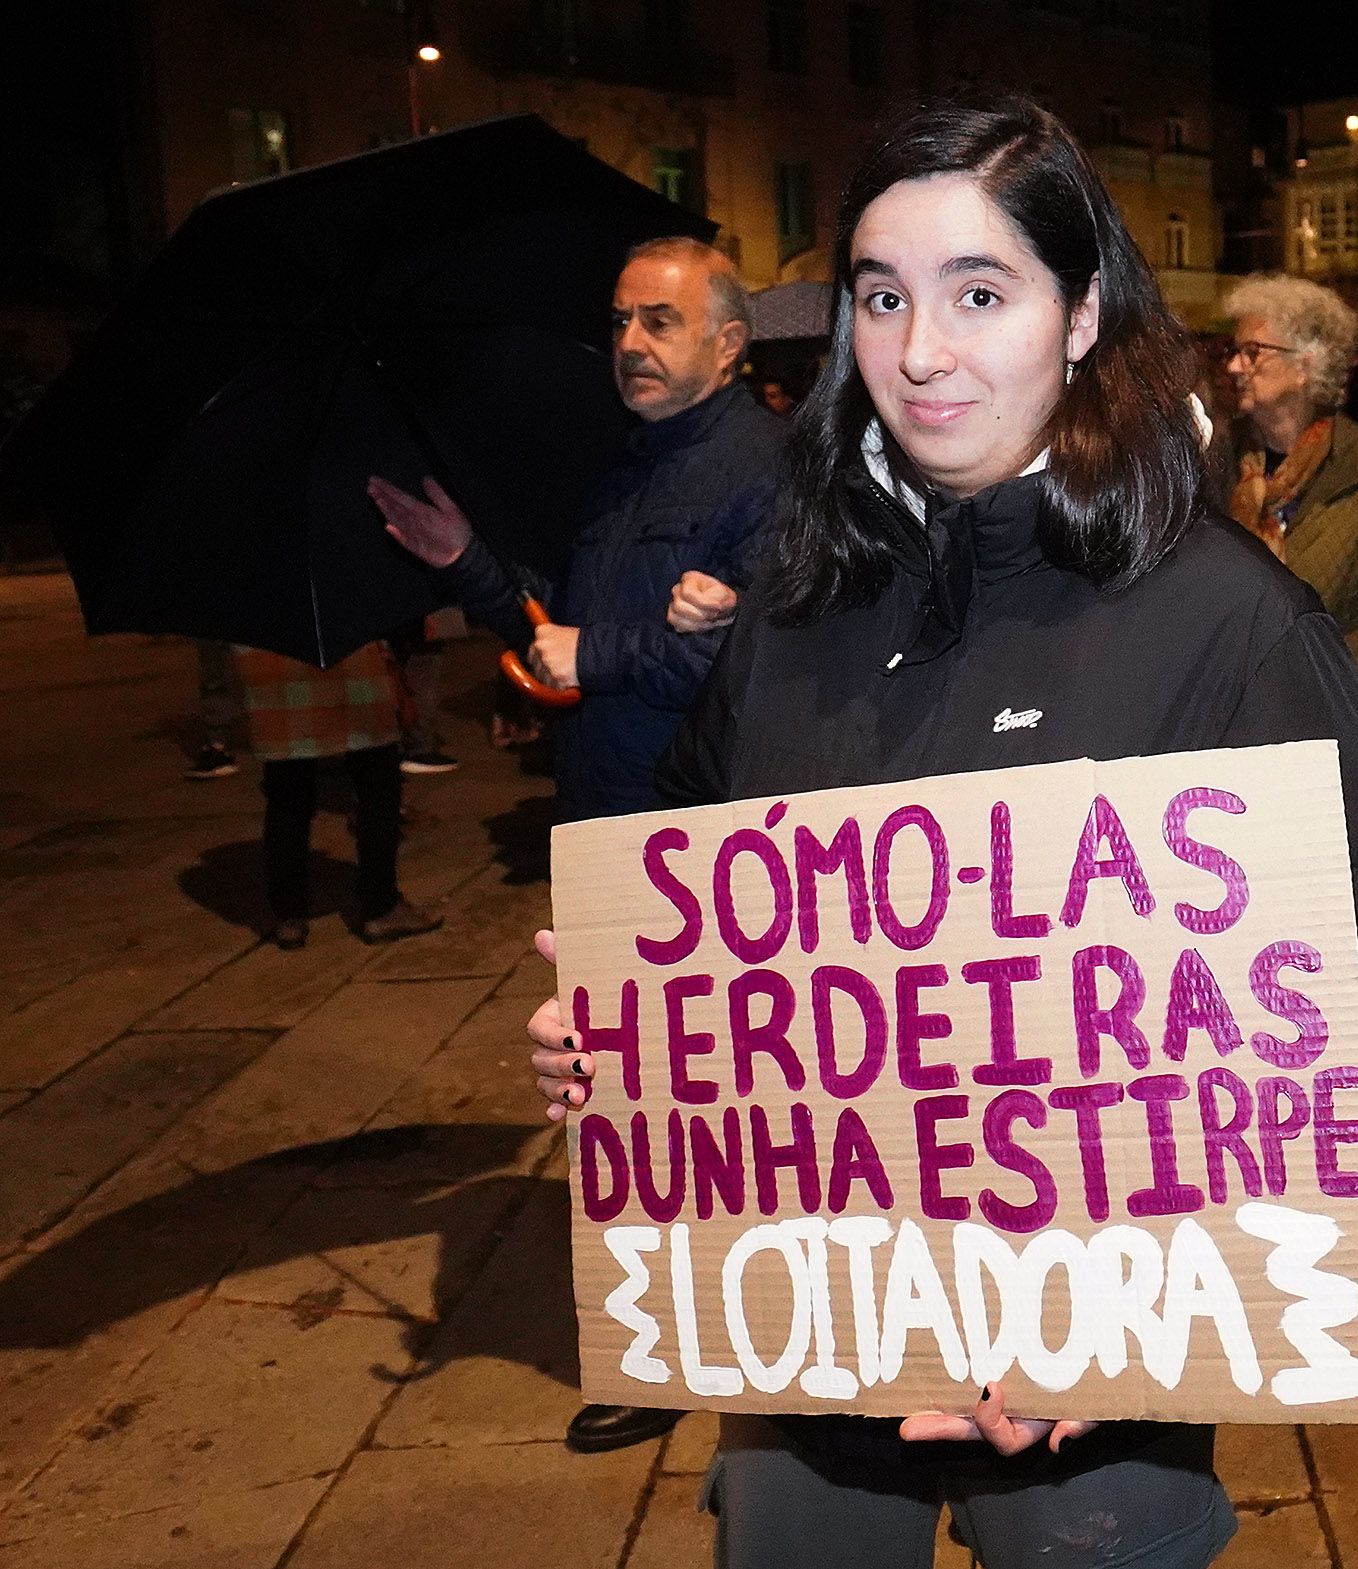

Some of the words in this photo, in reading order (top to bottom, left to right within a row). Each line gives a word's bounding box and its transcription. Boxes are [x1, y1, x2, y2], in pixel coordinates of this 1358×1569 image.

[635, 786, 1251, 966] SÓMO-LAS
[573, 939, 1330, 1106] HERDEIRAS
[579, 1104, 895, 1223] DUNHA
[670, 1216, 1264, 1399] LOITADORA
